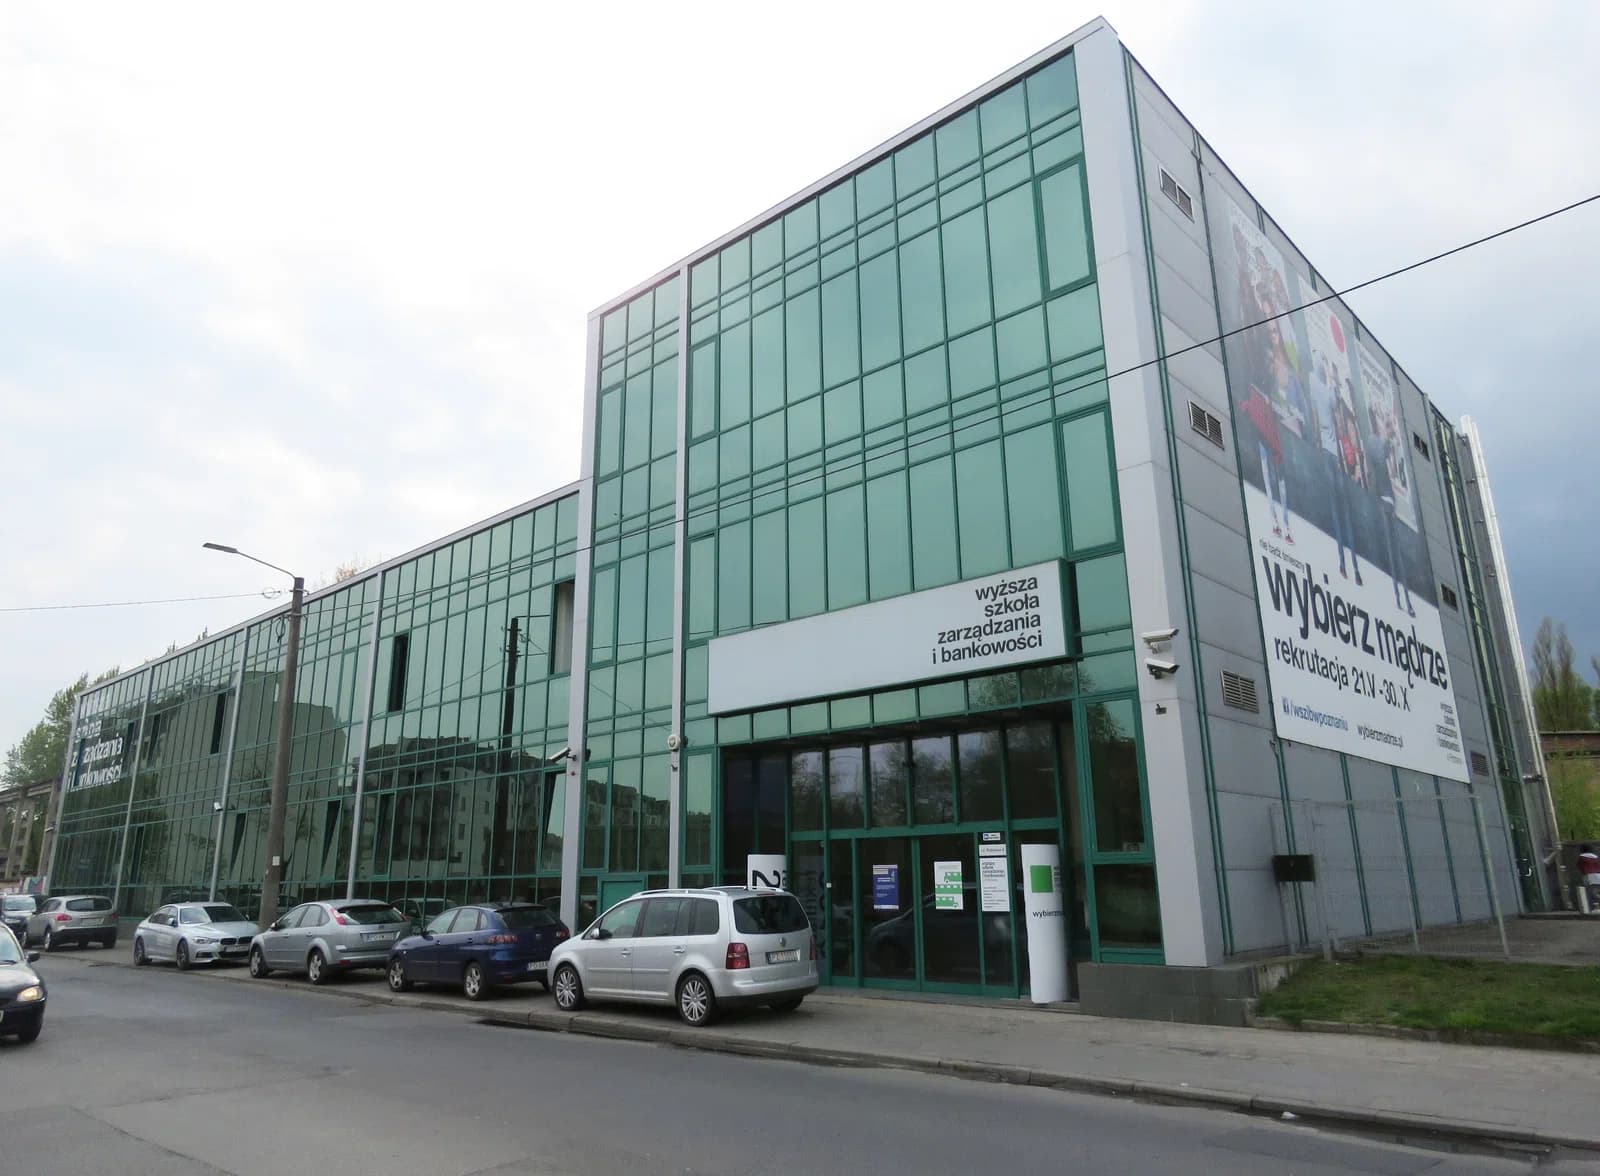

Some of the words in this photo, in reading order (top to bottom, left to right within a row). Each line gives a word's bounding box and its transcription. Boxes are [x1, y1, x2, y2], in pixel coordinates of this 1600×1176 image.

[975, 576, 1038, 602] wyższa
[984, 593, 1040, 618] szkoła
[937, 612, 1041, 645] zarządzania
[1262, 555, 1375, 655] wybierz
[1375, 617, 1447, 690] mądrze
[932, 648, 937, 664] i
[941, 630, 1043, 663] bankowości
[1274, 637, 1349, 691] rekrutacja
